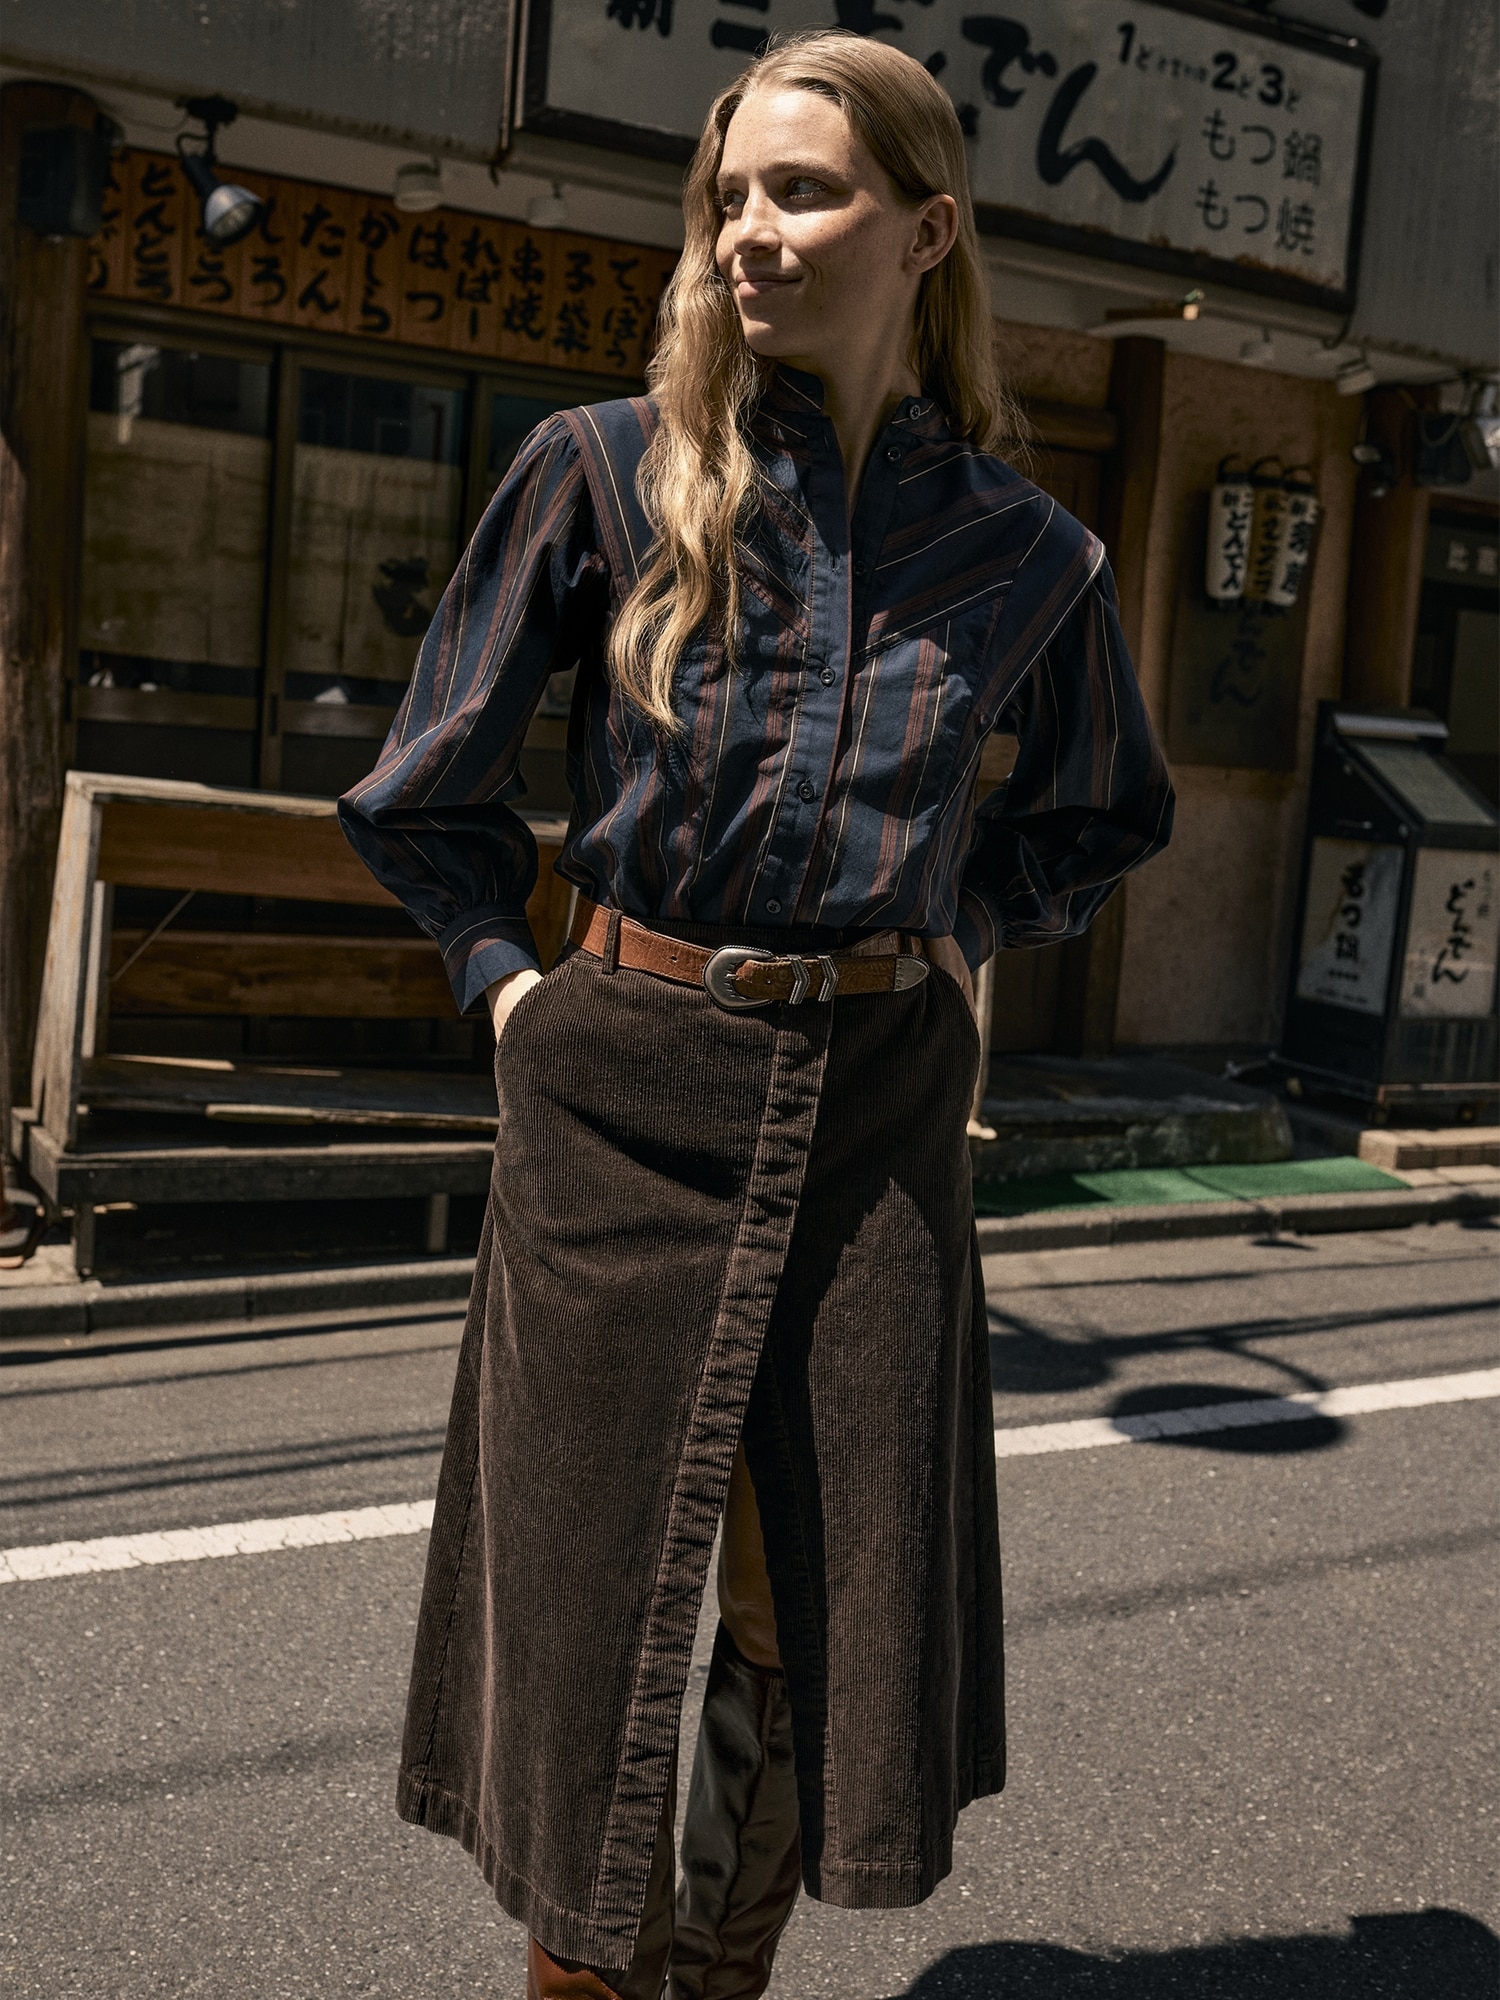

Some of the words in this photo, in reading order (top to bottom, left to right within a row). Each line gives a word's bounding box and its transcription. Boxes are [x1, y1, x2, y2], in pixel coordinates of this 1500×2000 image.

[1201, 107, 1322, 188] もつ鍋
[298, 203, 346, 313] たん
[1195, 179, 1314, 256] もつ焼
[356, 207, 401, 334] かしら
[406, 220, 450, 323] はつ
